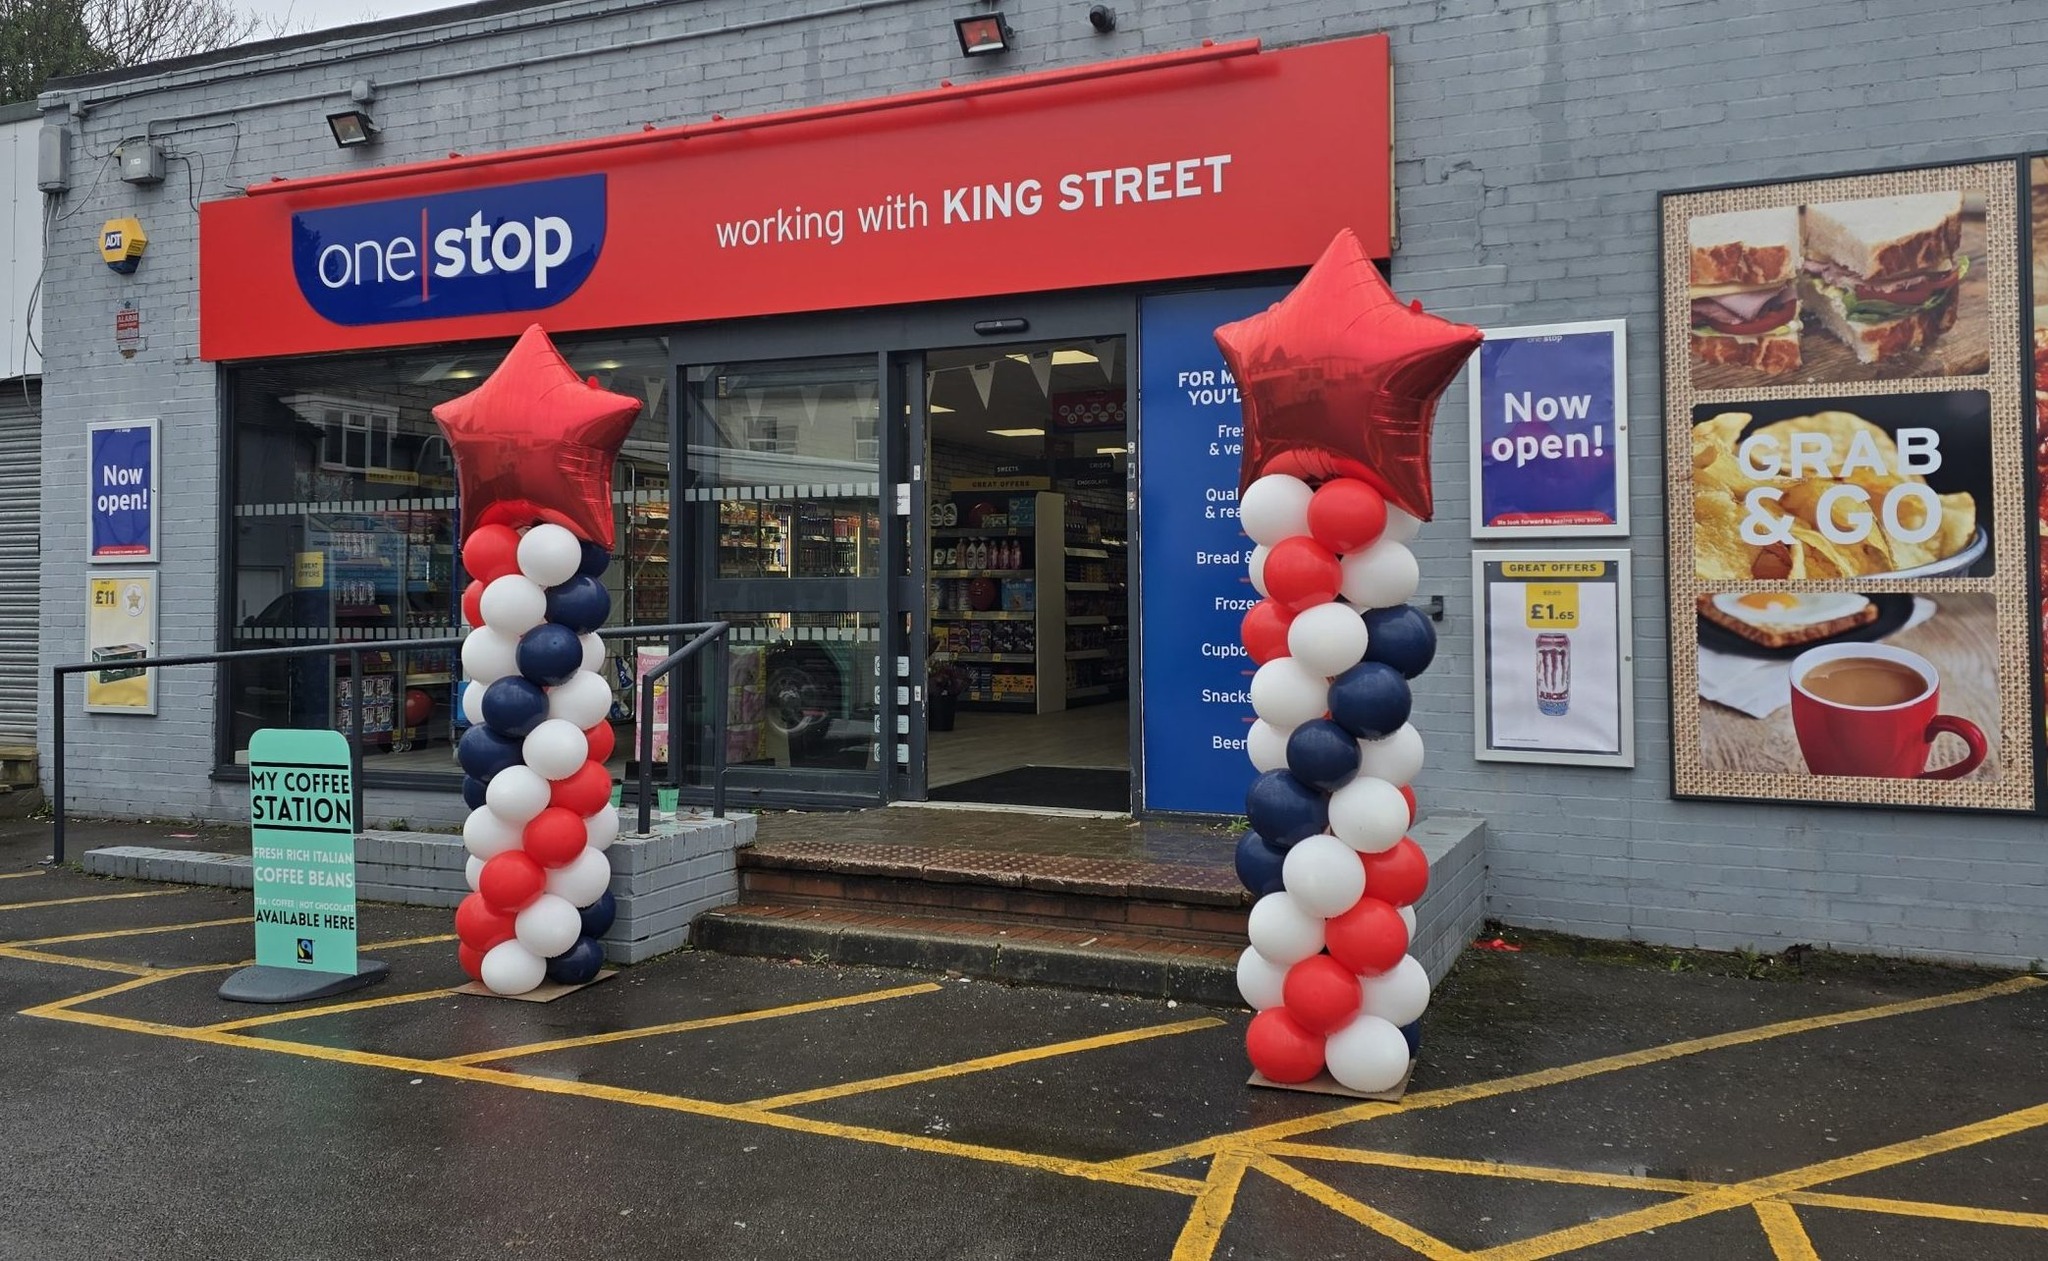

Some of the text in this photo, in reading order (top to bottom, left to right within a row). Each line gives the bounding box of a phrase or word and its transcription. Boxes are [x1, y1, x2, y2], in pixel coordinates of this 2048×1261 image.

[715, 154, 1232, 249] working with KING STREET
[105, 233, 121, 248] ADT
[318, 209, 573, 289] one stop
[1178, 370, 1215, 388] FOR
[1504, 391, 1592, 423] Now
[1209, 442, 1243, 456] & ve
[1491, 425, 1604, 468] open!
[1738, 427, 1943, 480] GRAB
[103, 465, 143, 486] Now
[1000, 480, 1030, 488] OFFERS
[97, 488, 147, 516] open!
[1205, 505, 1216, 519] &
[1739, 482, 1943, 546] & GO
[1196, 551, 1239, 565] Bread
[1509, 563, 1597, 573] GREAT OFFERS
[95, 590, 115, 605] £11
[1531, 603, 1575, 620] £1.65
[1202, 688, 1252, 703] Snacks
[251, 770, 350, 794] MY COFFEE
[252, 795, 351, 824] STATION
[254, 847, 353, 865] FRESH RICH ITALIAN
[254, 866, 353, 888] COFFEE BEANS
[271, 898, 295, 908] COFFEE
[299, 900, 313, 910] HOT
[315, 902, 354, 913] CHOCOLATE
[256, 909, 355, 931] AVAILABLE HERE
